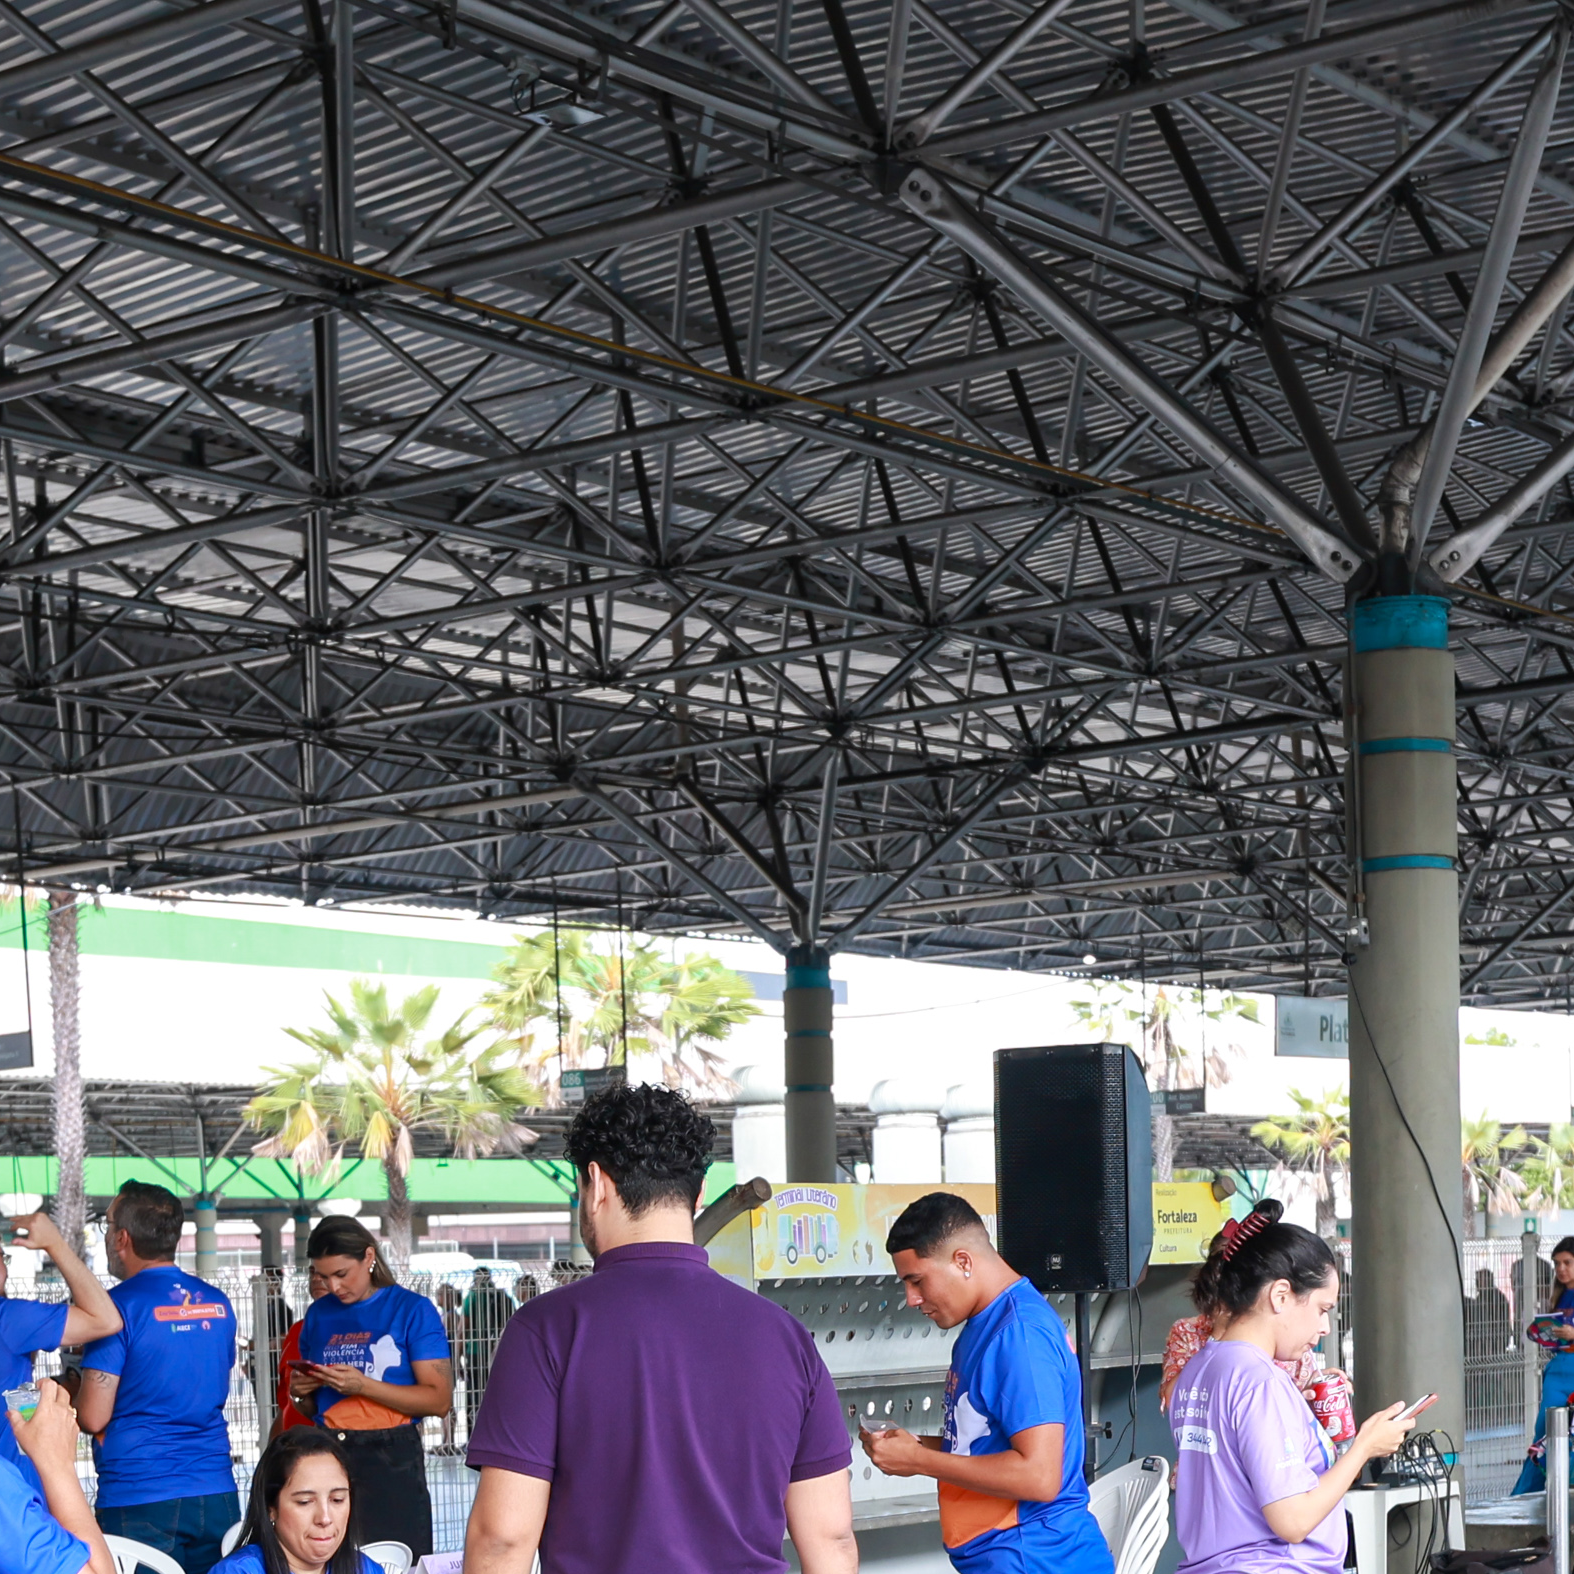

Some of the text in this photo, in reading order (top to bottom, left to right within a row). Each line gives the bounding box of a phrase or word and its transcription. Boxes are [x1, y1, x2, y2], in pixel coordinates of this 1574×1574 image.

[561, 1073, 581, 1086] 086
[1157, 1209, 1197, 1224] Fortaleza
[1159, 1244, 1177, 1252] Cultura
